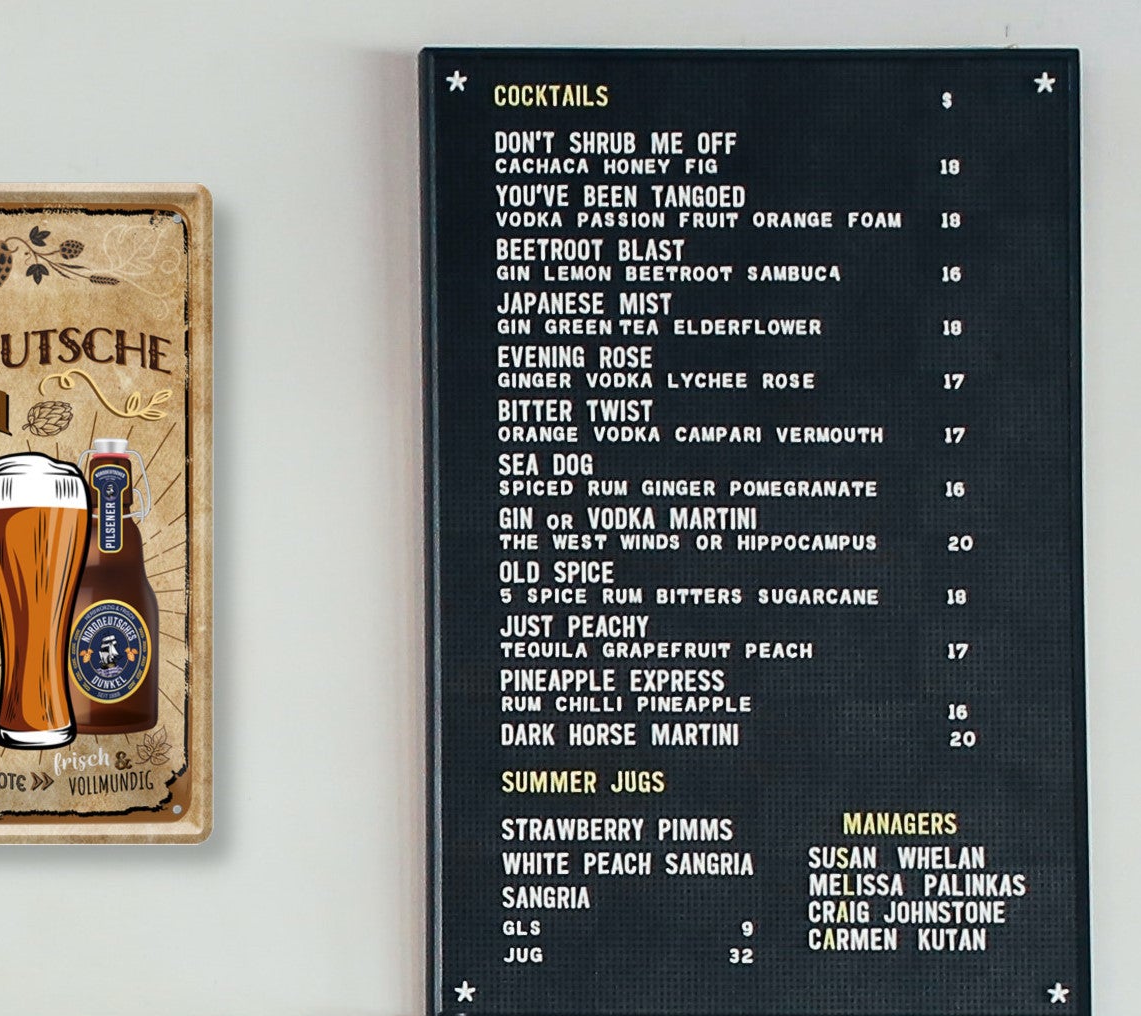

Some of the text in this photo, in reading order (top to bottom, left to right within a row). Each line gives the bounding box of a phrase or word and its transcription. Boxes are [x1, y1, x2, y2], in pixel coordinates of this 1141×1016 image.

[494, 84, 609, 107] COCKTAILS
[941, 91, 953, 110] $
[494, 130, 737, 155] DON'T SHRUB ME OFF
[495, 157, 960, 176] CACHACA HONEY FIG 18
[495, 183, 746, 209] YOU'VE BEEN TANGOED
[495, 211, 961, 229] VODKA PASSION FRUIT ORANGE FOAM 18
[496, 238, 685, 262] BEETROOT BLAST
[496, 291, 672, 316] JAPANESE MIST
[497, 318, 962, 336] GIN GREEN TEA ELDERFLOWER 18
[497, 345, 653, 370] EVENING ROSE
[498, 399, 653, 423] BITTER TWIST
[498, 453, 594, 476] SEA DOG
[499, 479, 965, 498] SPICED RUM GINGER POMEGRANATE 16
[105, 502, 116, 549] PILSENER
[499, 506, 757, 531] GIN OR VODKA MARTINI
[499, 533, 974, 552] THE WEST WINDS OR HIPPOCAMPUS 20
[499, 560, 615, 584] OLD SPICE
[81, 615, 137, 643] NORDDEUTSCHES
[499, 614, 649, 639] JUST PEACHY
[500, 641, 969, 660] TEQUILA GRAPEFRUIT PEACH 17
[91, 675, 127, 689] DUNKEL
[500, 668, 725, 693] PINEAPPLE EXPRESS
[501, 722, 977, 748] DARK HORSE MARTINI 20
[53, 747, 133, 777] frisch &
[68, 769, 155, 796] VOLLMUNDIG
[501, 770, 665, 794] SUMMER JUGS
[501, 817, 734, 842] STRAWBERRY PIMMS
[843, 812, 958, 836] MANAGERS
[502, 851, 754, 876] WHITE PEACH SANGRIA
[808, 845, 985, 870] SUSAN WHELAN
[502, 885, 591, 910] SANGRIA
[809, 873, 1027, 898] MELISSA PALINKAS
[808, 900, 1006, 925] CRAIG JOHNSTONE
[502, 920, 754, 937] GLS 9
[808, 927, 987, 952] CARMEN KUTAN
[503, 946, 754, 964] JUG 32
